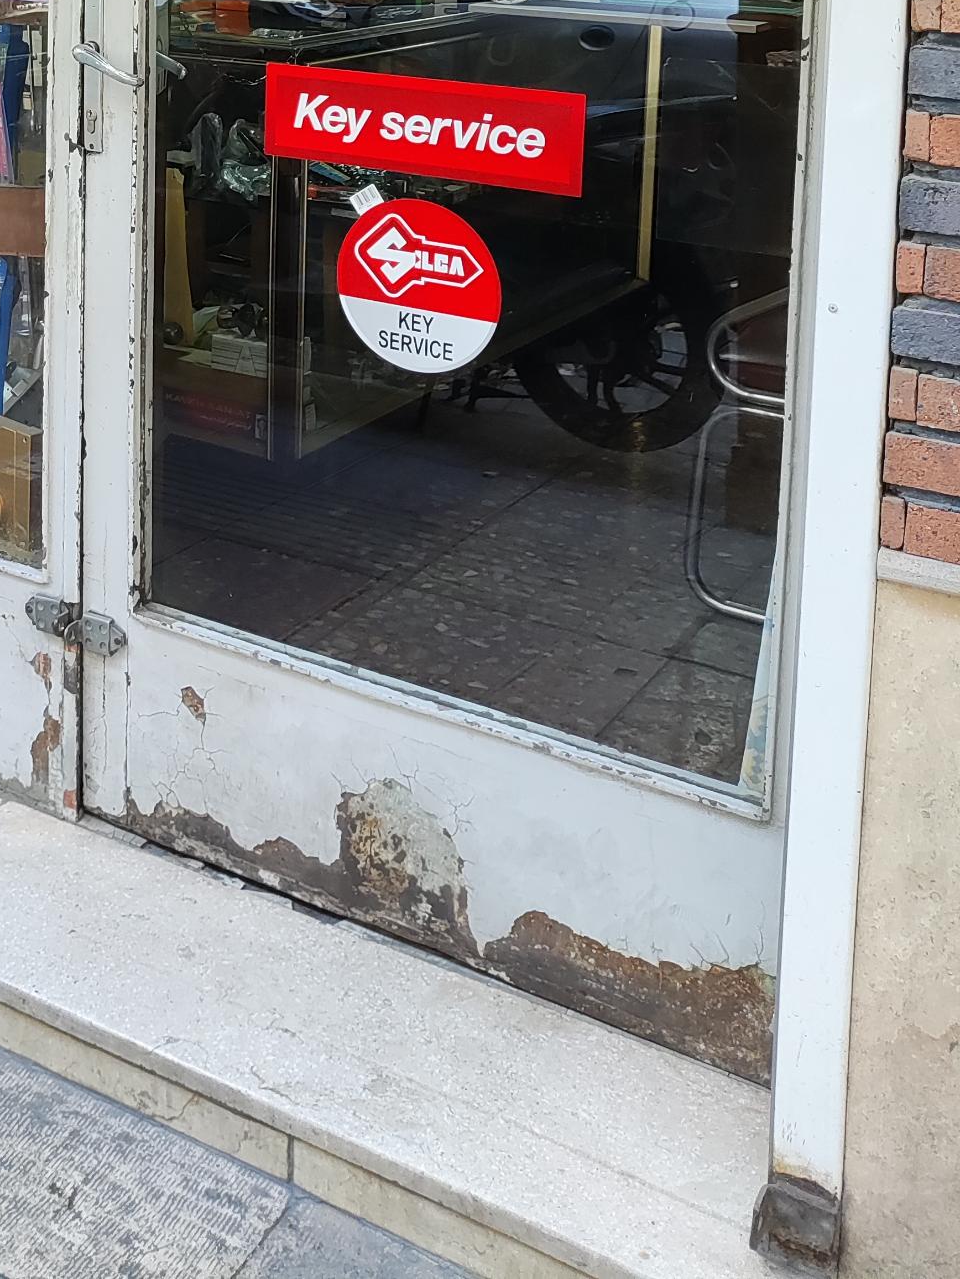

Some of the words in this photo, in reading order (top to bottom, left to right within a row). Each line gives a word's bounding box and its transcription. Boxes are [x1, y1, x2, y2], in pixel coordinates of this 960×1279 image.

[293, 92, 372, 143] Key
[380, 110, 546, 159] service
[366, 227, 465, 285] SILCA
[398, 311, 434, 335] KEY
[378, 330, 454, 362] SERVICE
